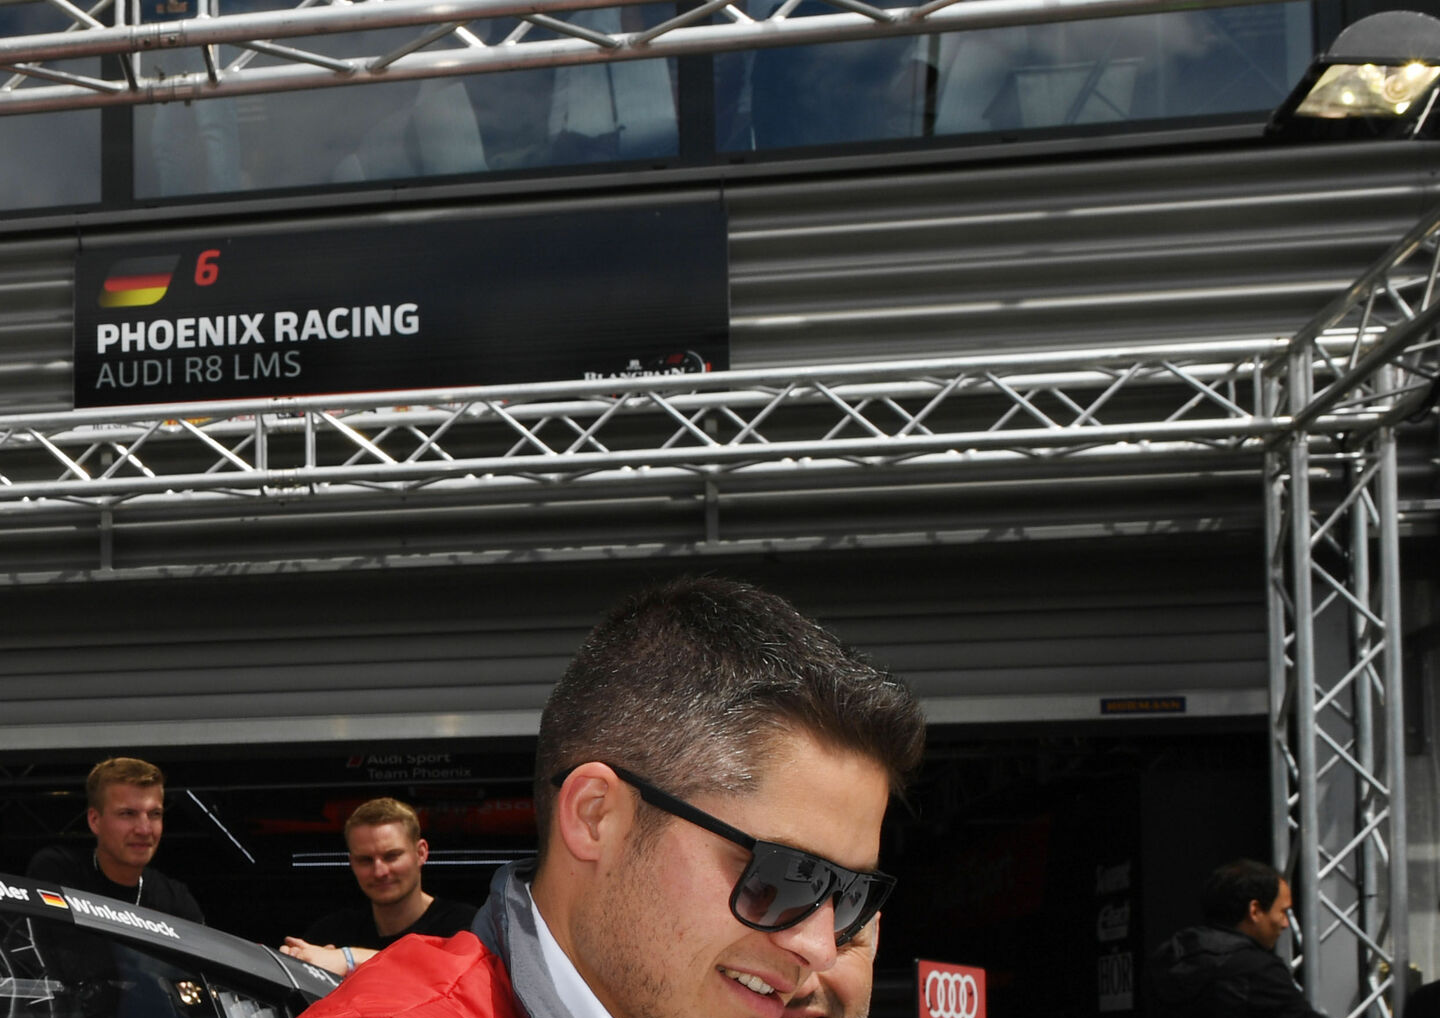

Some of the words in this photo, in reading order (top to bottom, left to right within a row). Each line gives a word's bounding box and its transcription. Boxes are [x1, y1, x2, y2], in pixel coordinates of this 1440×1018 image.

[193, 249, 221, 288] 6
[96, 312, 265, 355] PHOENIX
[275, 302, 420, 343] RACING
[96, 357, 172, 390] AUDI
[185, 355, 223, 383] R8
[234, 349, 303, 380] LMS
[366, 753, 403, 767] Audi
[407, 752, 452, 769] Sport
[367, 767, 409, 780] Team
[412, 766, 472, 780] Phoenix
[66, 894, 181, 940] Winkelhock
